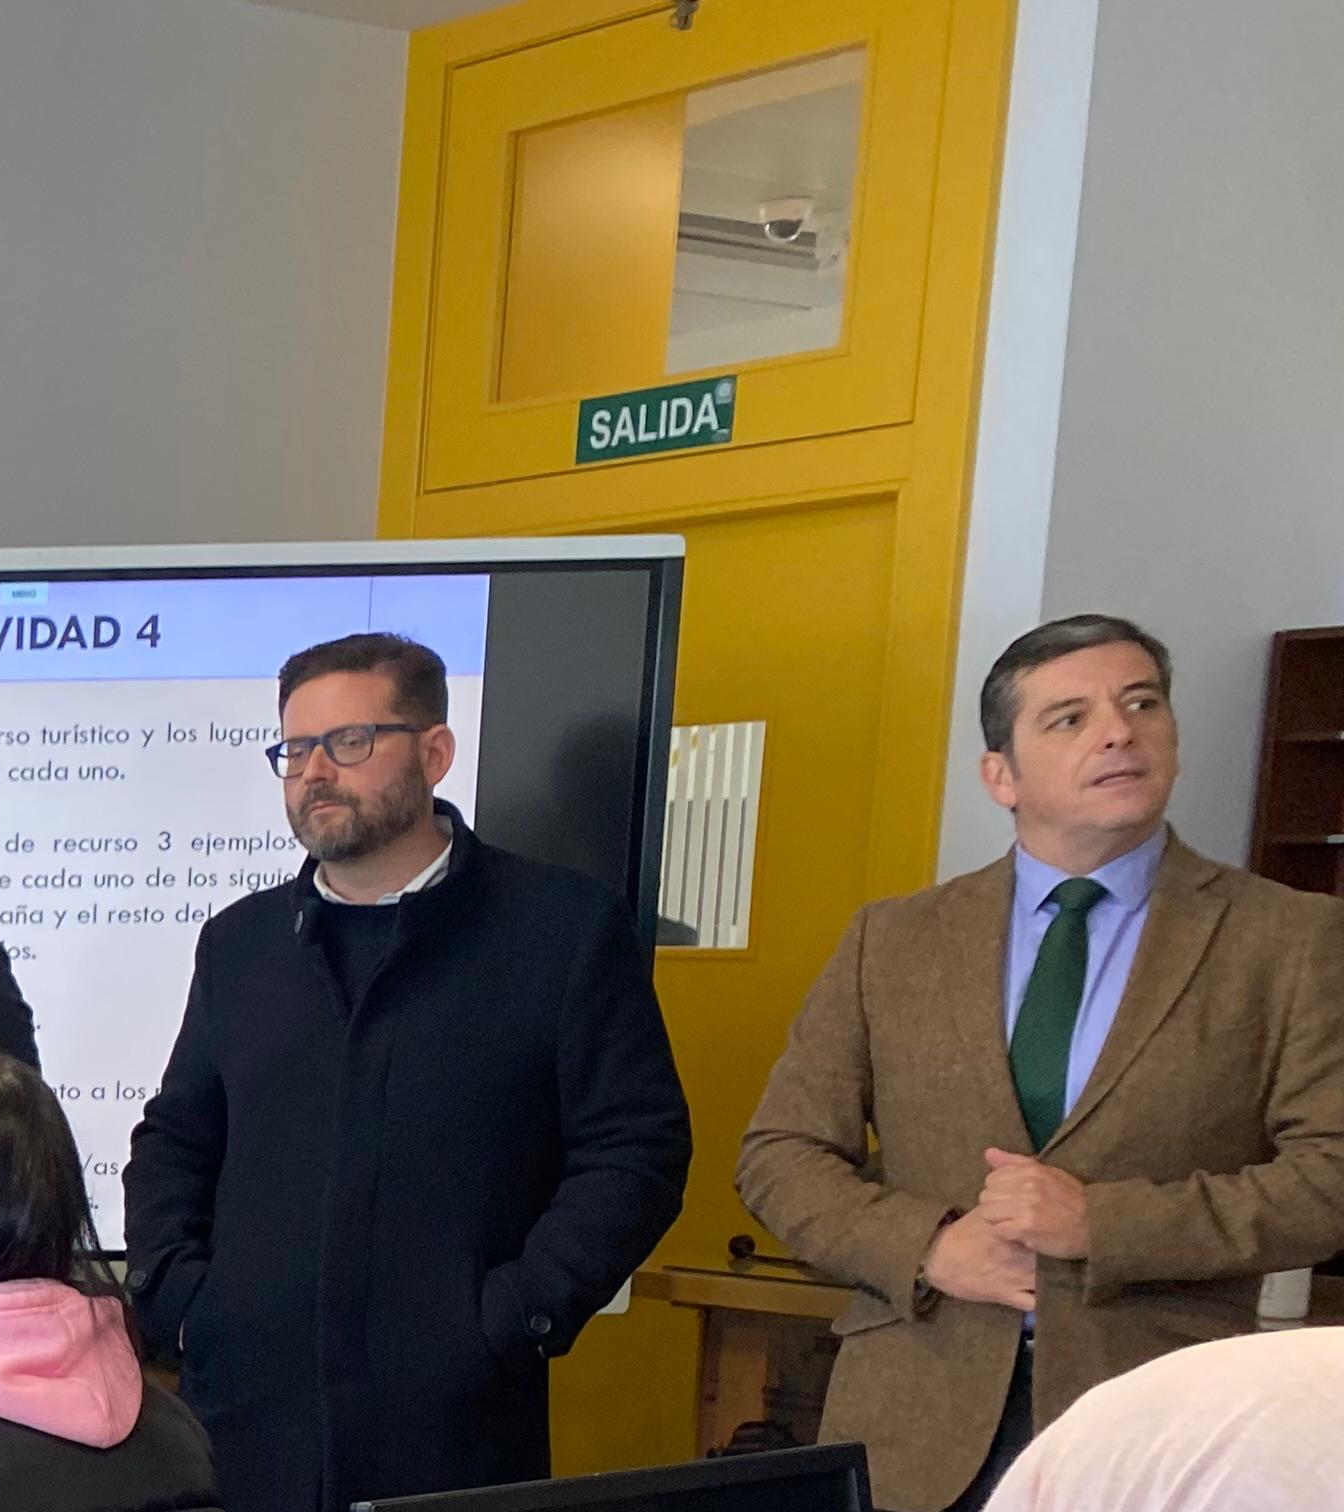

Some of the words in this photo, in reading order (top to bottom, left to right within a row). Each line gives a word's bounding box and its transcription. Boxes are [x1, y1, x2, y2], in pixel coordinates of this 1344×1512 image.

[590, 393, 719, 449] SALIDA
[135, 613, 161, 648] 4
[42, 724, 130, 746] turístico
[141, 728, 155, 748] y
[167, 722, 198, 742] los
[210, 721, 283, 747] lugare
[8, 760, 69, 782] cada
[78, 764, 126, 781] uno.
[4, 832, 35, 853] de
[53, 834, 138, 852] recurso
[158, 831, 172, 852] 3
[190, 829, 298, 856] ejemplos
[22, 867, 82, 888] cada
[94, 872, 134, 888] uno
[145, 866, 176, 887] de
[187, 866, 218, 887] los
[228, 866, 296, 890] siguie
[54, 910, 67, 930] y
[77, 904, 98, 924] el
[108, 905, 165, 923] resto
[174, 903, 213, 923] del
[90, 1085, 105, 1099] a
[115, 1080, 146, 1099] los
